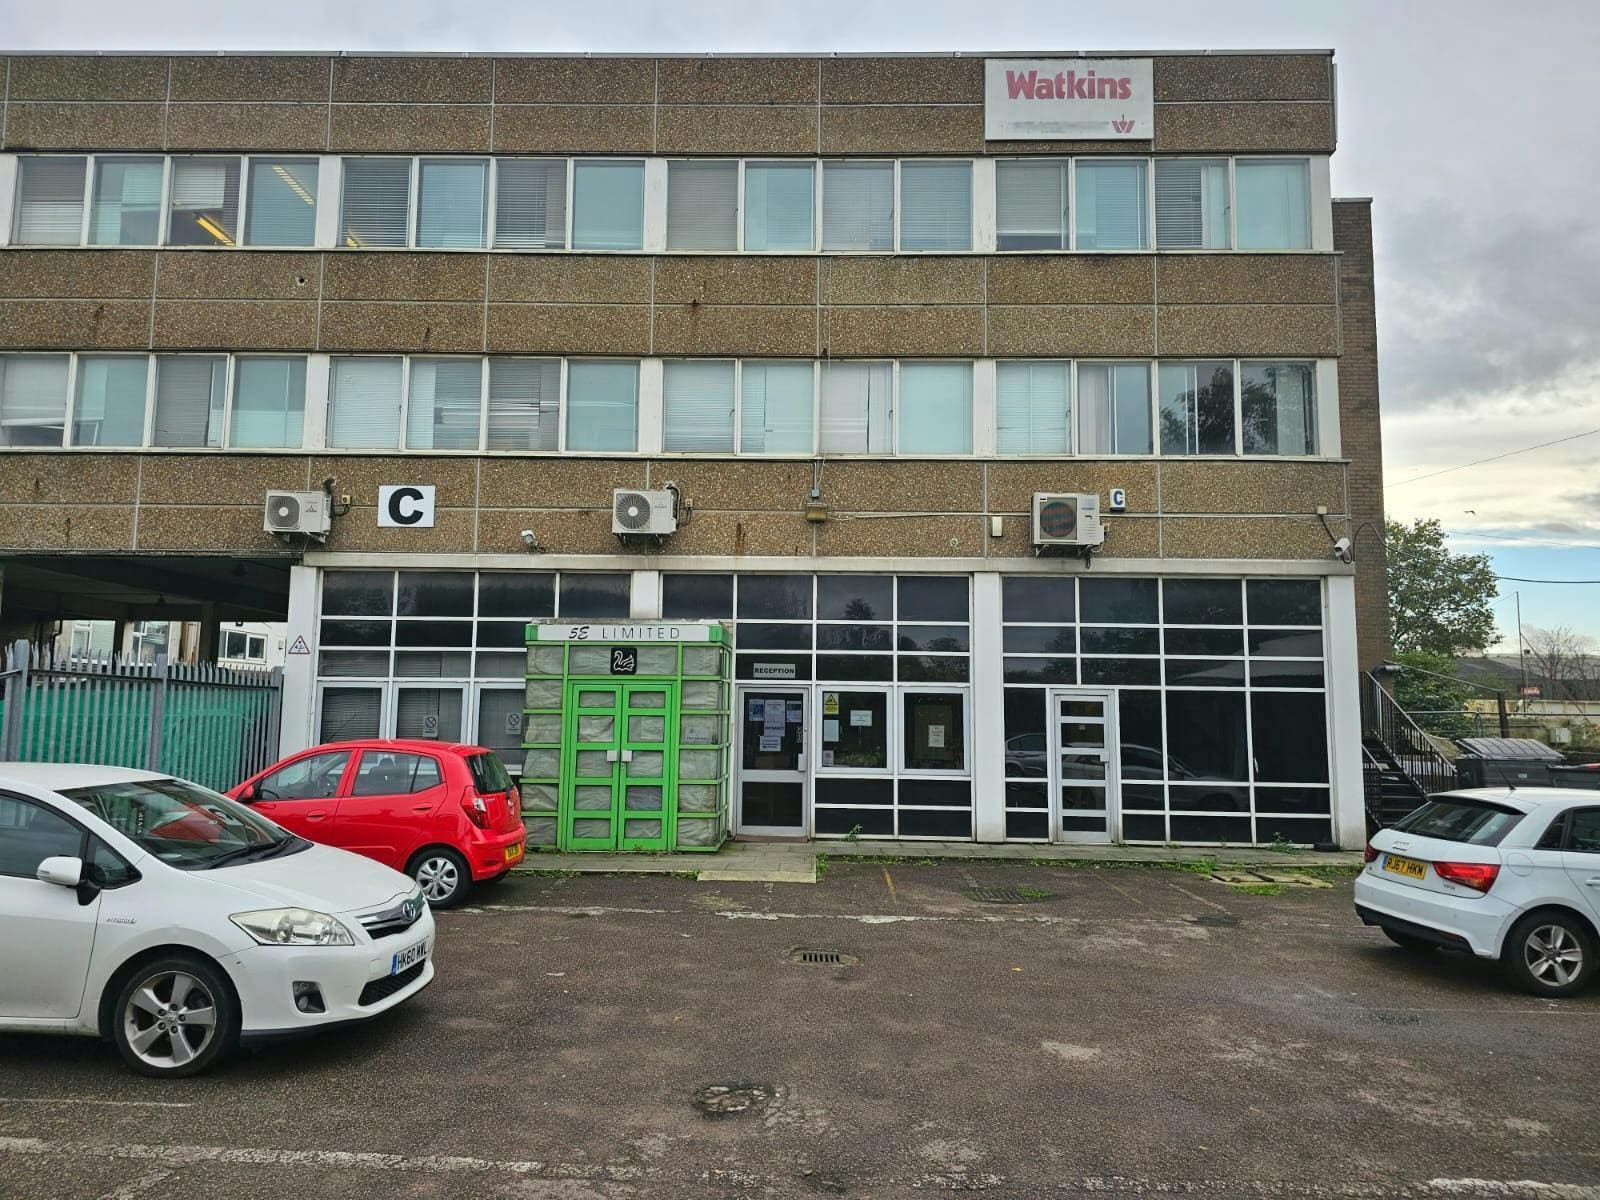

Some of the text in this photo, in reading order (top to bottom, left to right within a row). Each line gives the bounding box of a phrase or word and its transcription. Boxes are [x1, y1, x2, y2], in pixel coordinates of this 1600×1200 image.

[1006, 70, 1131, 100] Watkins
[388, 487, 424, 525] C
[1113, 490, 1124, 506] C
[602, 627, 680, 639] LIMITED
[754, 667, 795, 675] RECEPTION
[397, 947, 415, 970] HK60
